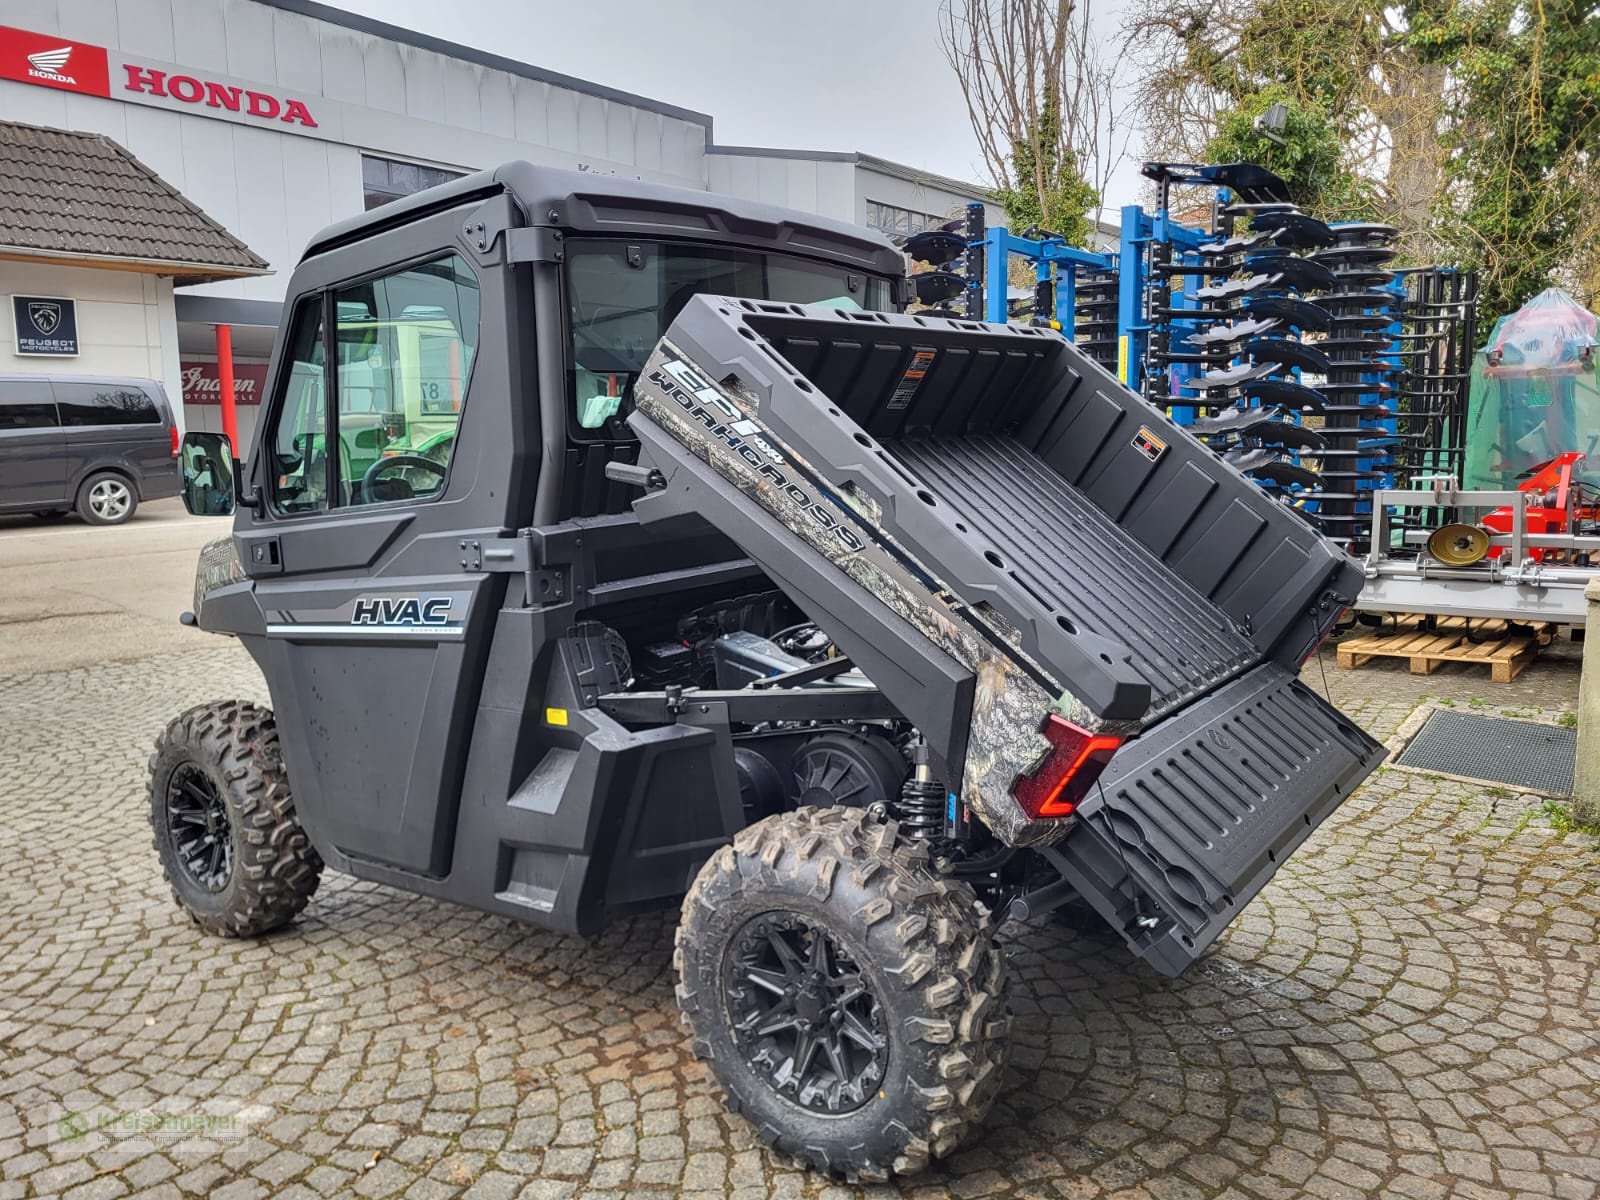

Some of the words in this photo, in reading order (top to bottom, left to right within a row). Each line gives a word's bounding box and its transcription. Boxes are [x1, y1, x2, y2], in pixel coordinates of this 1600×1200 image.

[28, 68, 77, 86] HONDA
[122, 63, 318, 128] HONDA
[19, 338, 75, 347] PEUGEOT
[660, 359, 763, 437] EFI
[646, 370, 866, 553] WORKCROSS
[351, 597, 453, 626] HVAC
